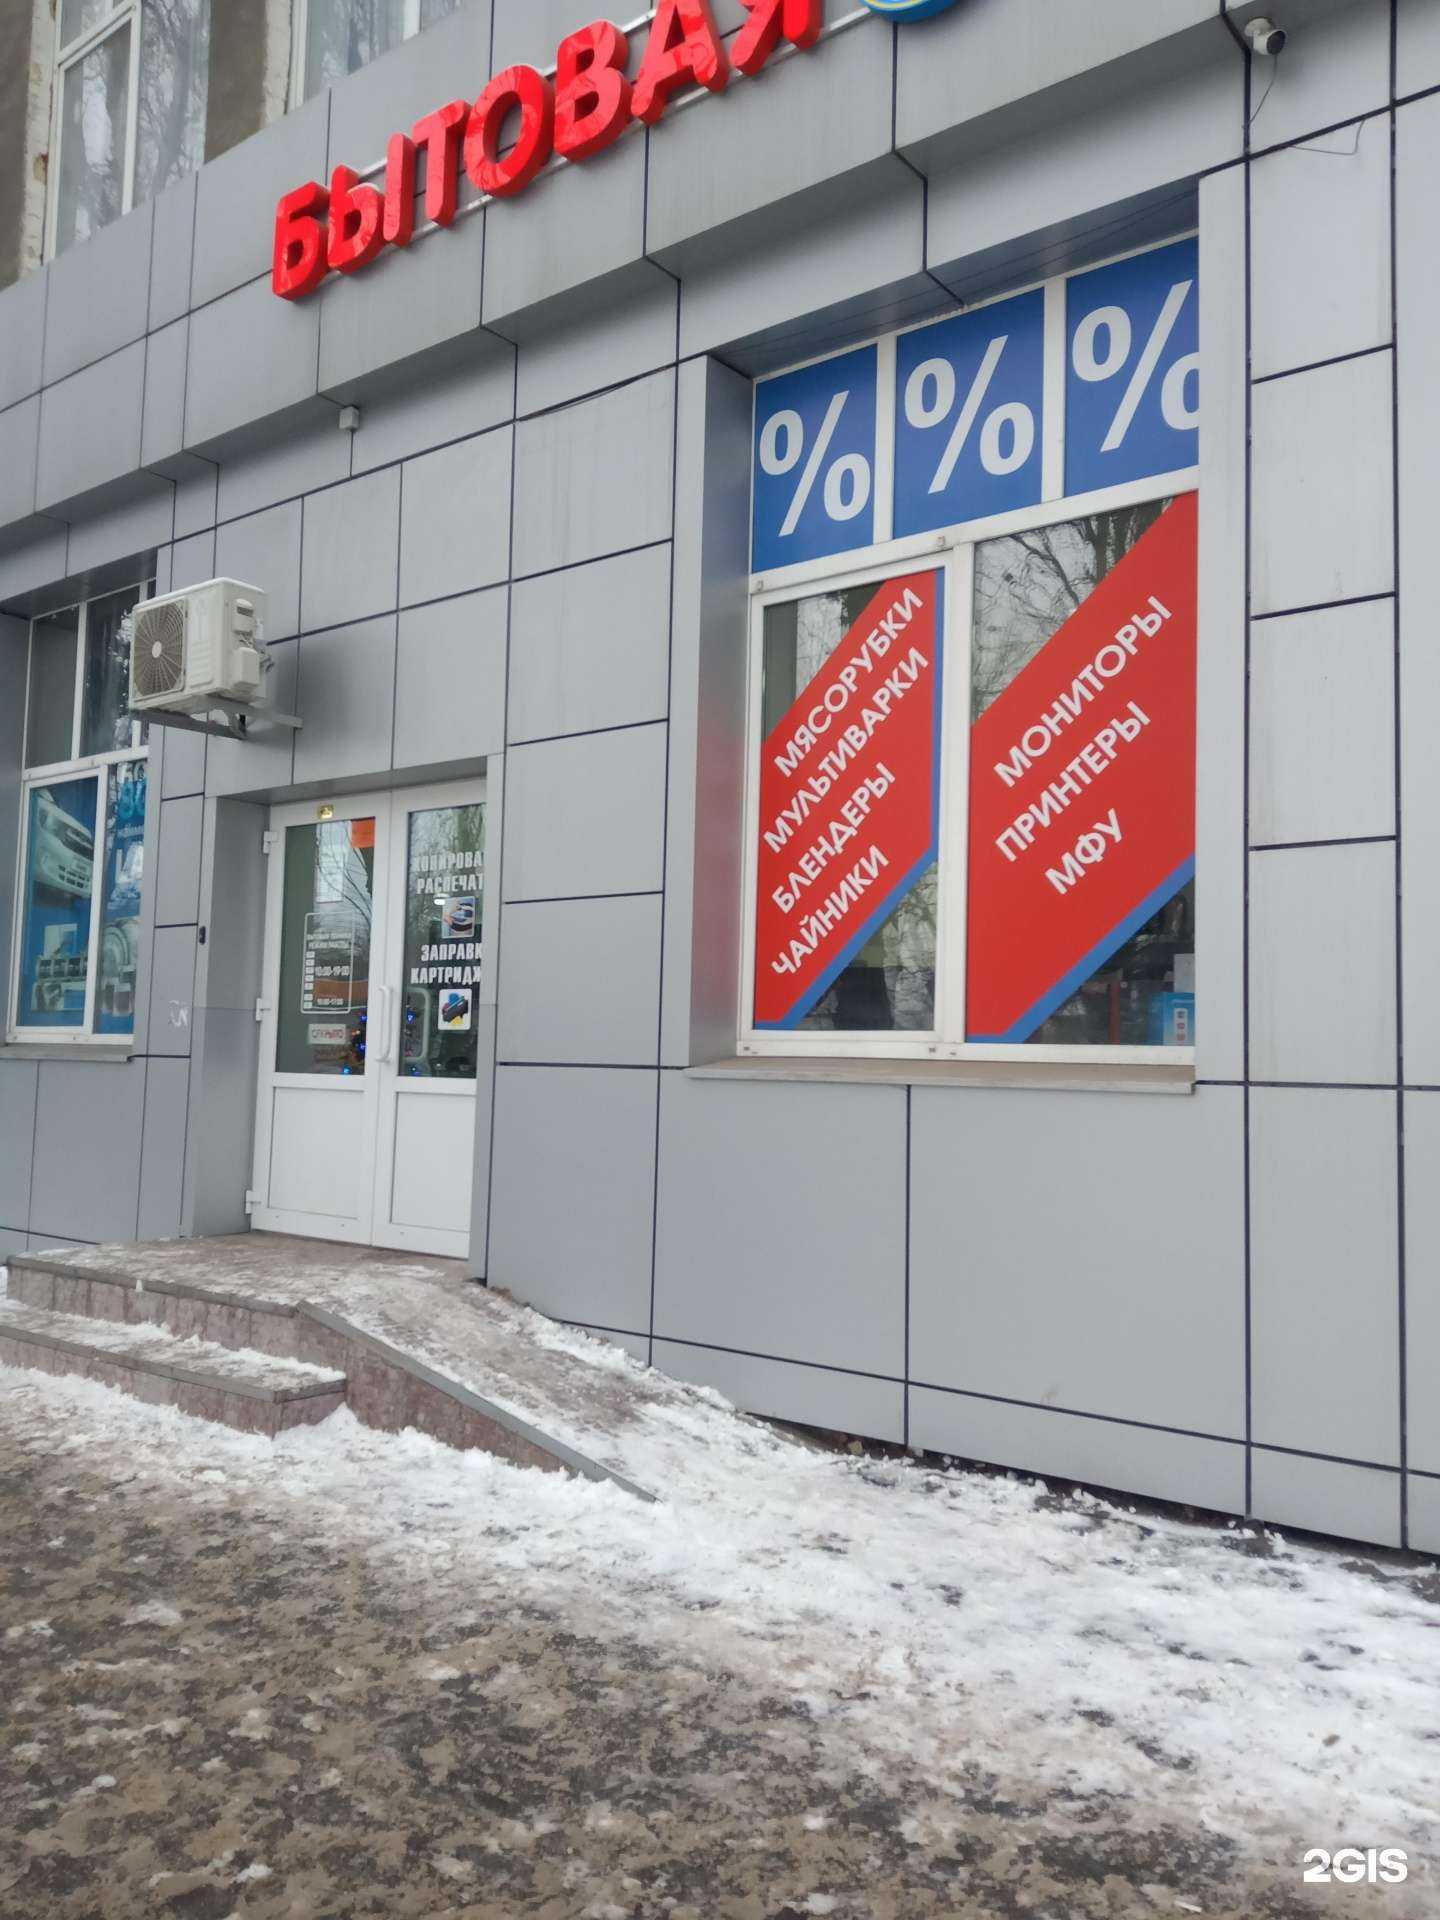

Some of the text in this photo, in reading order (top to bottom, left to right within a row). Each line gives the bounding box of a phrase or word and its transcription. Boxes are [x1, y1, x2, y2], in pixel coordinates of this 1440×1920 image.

[763, 647, 929, 854] МУЛЬТИВАРКИ
[773, 587, 923, 778] МЯСОРУБКИ
[993, 596, 1173, 788] МОНИТОРЫ
[771, 762, 896, 914] БЛЕНДЕРЫ
[995, 701, 1151, 862] ПРИНТЕРЫ
[1044, 807, 1124, 895] МФУ
[770, 844, 889, 975] ЧАЙНИКИ
